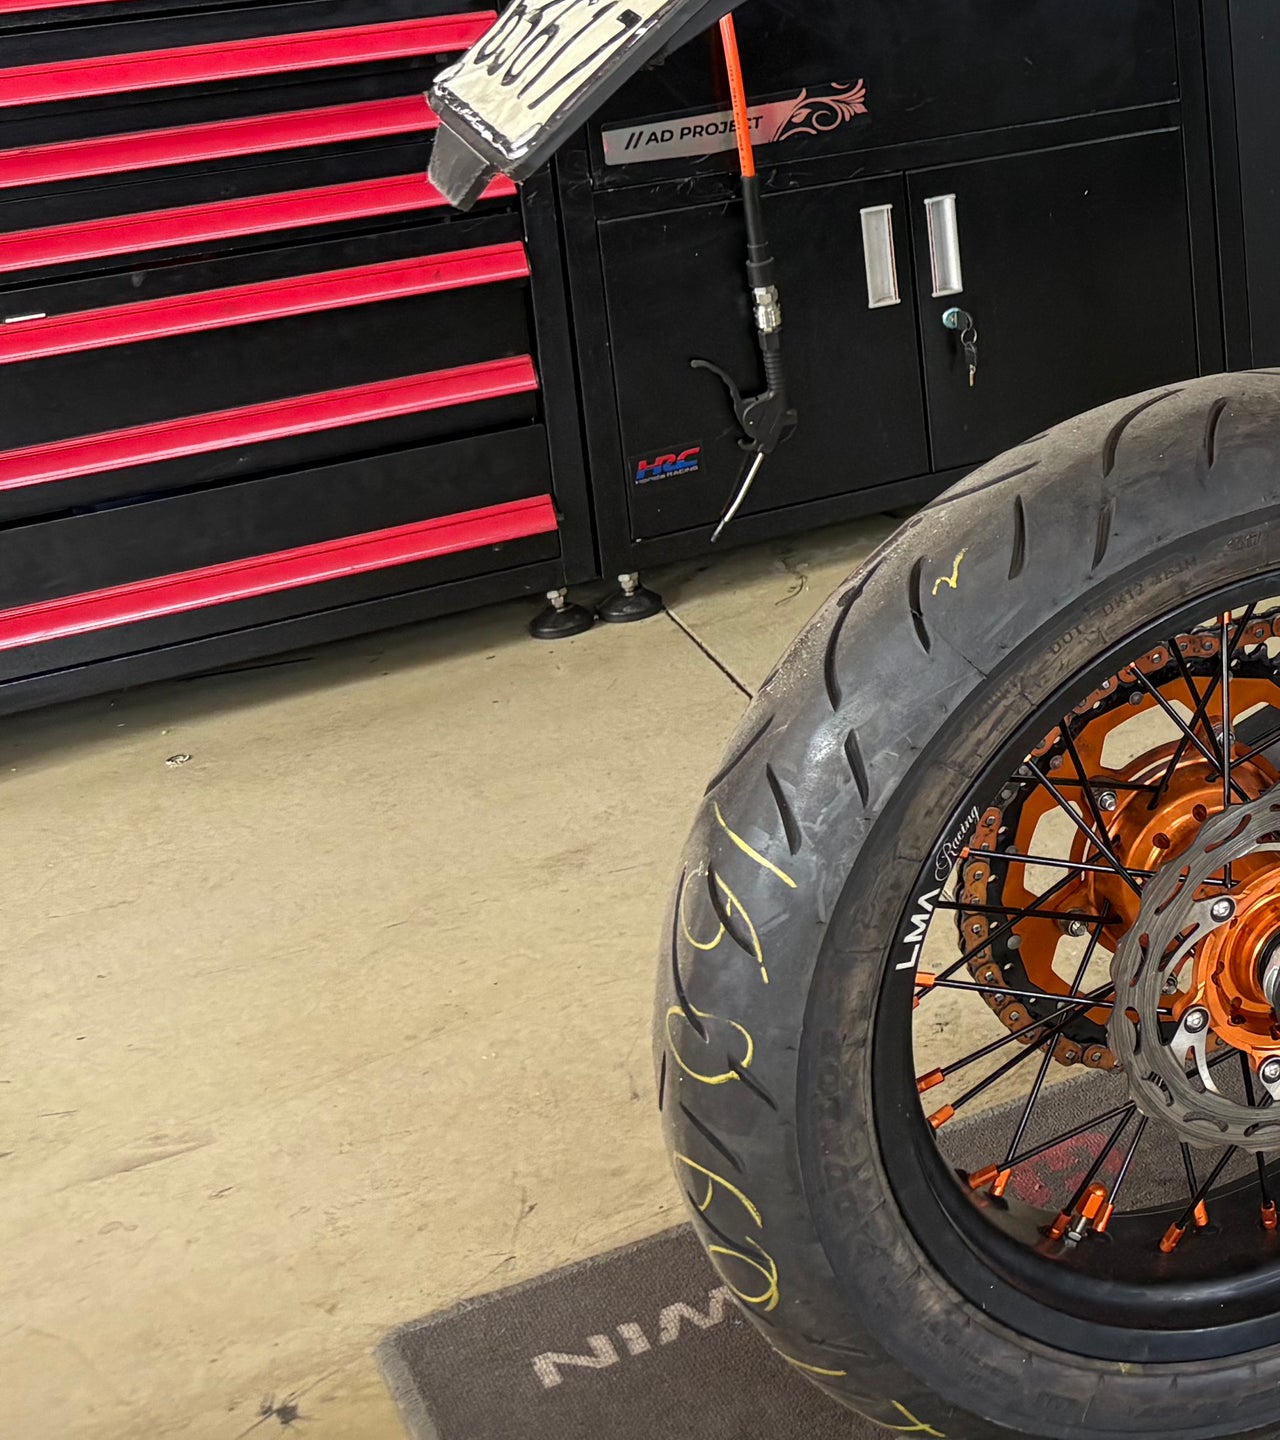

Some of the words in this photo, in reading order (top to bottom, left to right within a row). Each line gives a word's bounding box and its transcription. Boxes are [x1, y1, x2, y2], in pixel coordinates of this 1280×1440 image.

[636, 446, 700, 480] HRC
[666, 465, 699, 478] RACING
[895, 888, 941, 971] LMA
[935, 805, 980, 882] Racing
